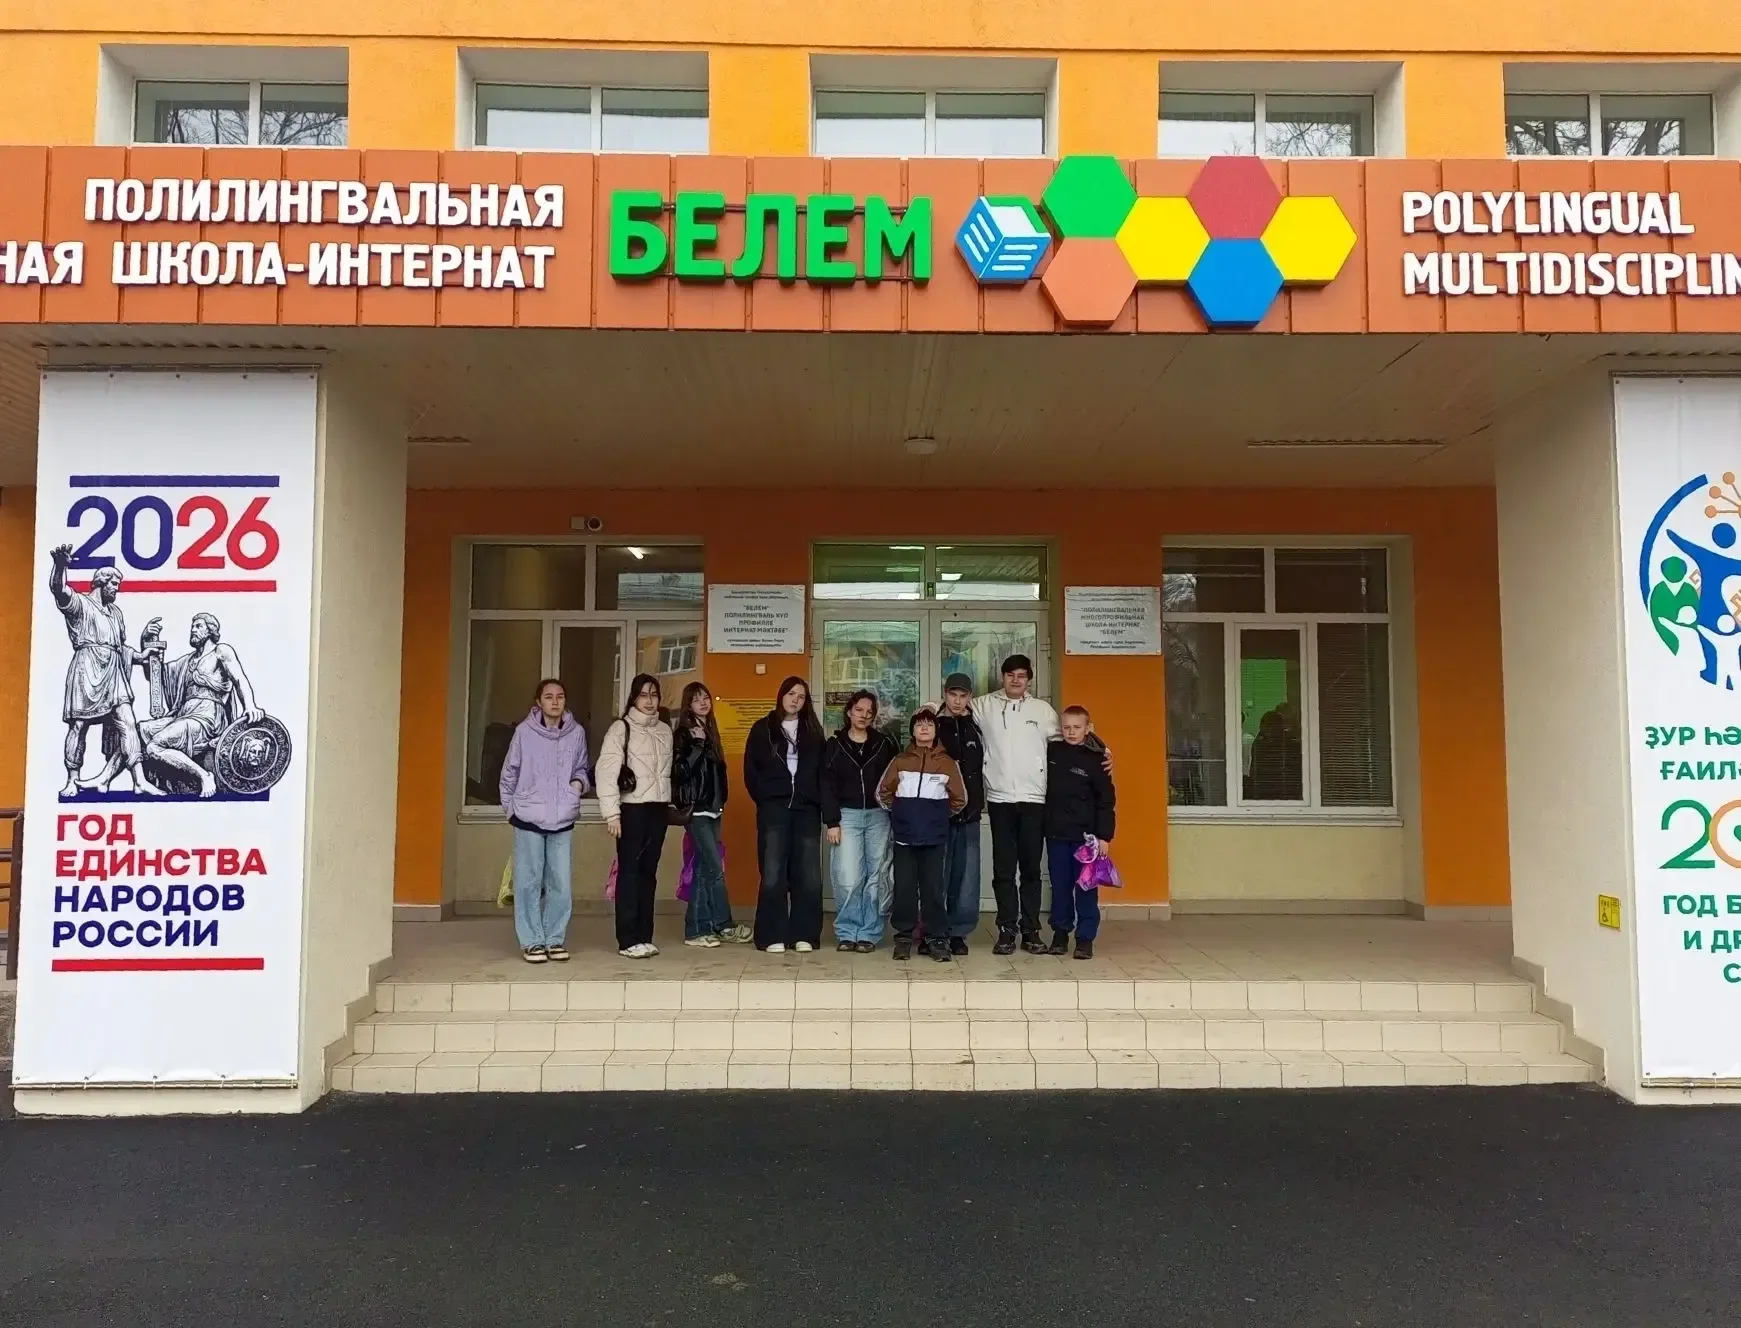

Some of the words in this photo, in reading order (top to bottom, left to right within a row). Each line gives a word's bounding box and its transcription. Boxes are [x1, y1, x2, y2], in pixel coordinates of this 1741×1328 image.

[85, 178, 565, 228] ПОЛИЛИНГВАЛЬНАЯ
[1402, 191, 1695, 235] POLYLINGUAL
[611, 191, 931, 281] БЕЛЕМ
[112, 241, 555, 289] ШКОЛА-ИНТЕРНАТ
[66, 495, 280, 570] 2026
[1659, 760, 1741, 781] ҒАИЛ
[57, 814, 135, 845] ГОД
[56, 848, 267, 881] ЕДИНСТВА
[54, 883, 245, 916] НАРОДОВ
[1663, 894, 1719, 918] ГОД
[52, 919, 219, 948] РОССИИ
[1684, 930, 1703, 950] И
